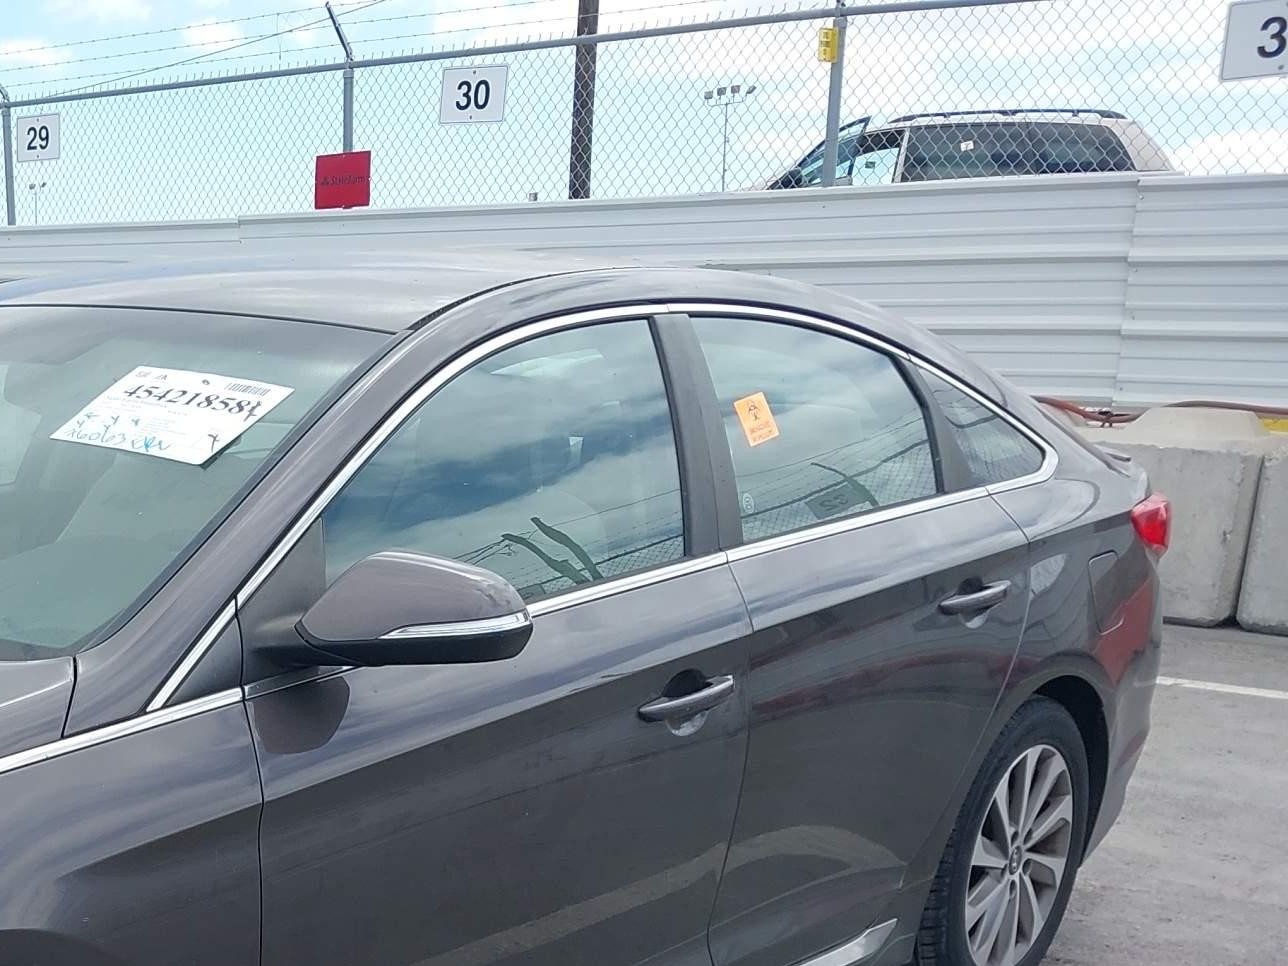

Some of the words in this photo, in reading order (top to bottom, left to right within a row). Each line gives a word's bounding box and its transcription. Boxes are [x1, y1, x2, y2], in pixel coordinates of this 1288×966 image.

[1257, 16, 1287, 58] 3
[455, 79, 490, 110] 30
[27, 125, 50, 150] 29
